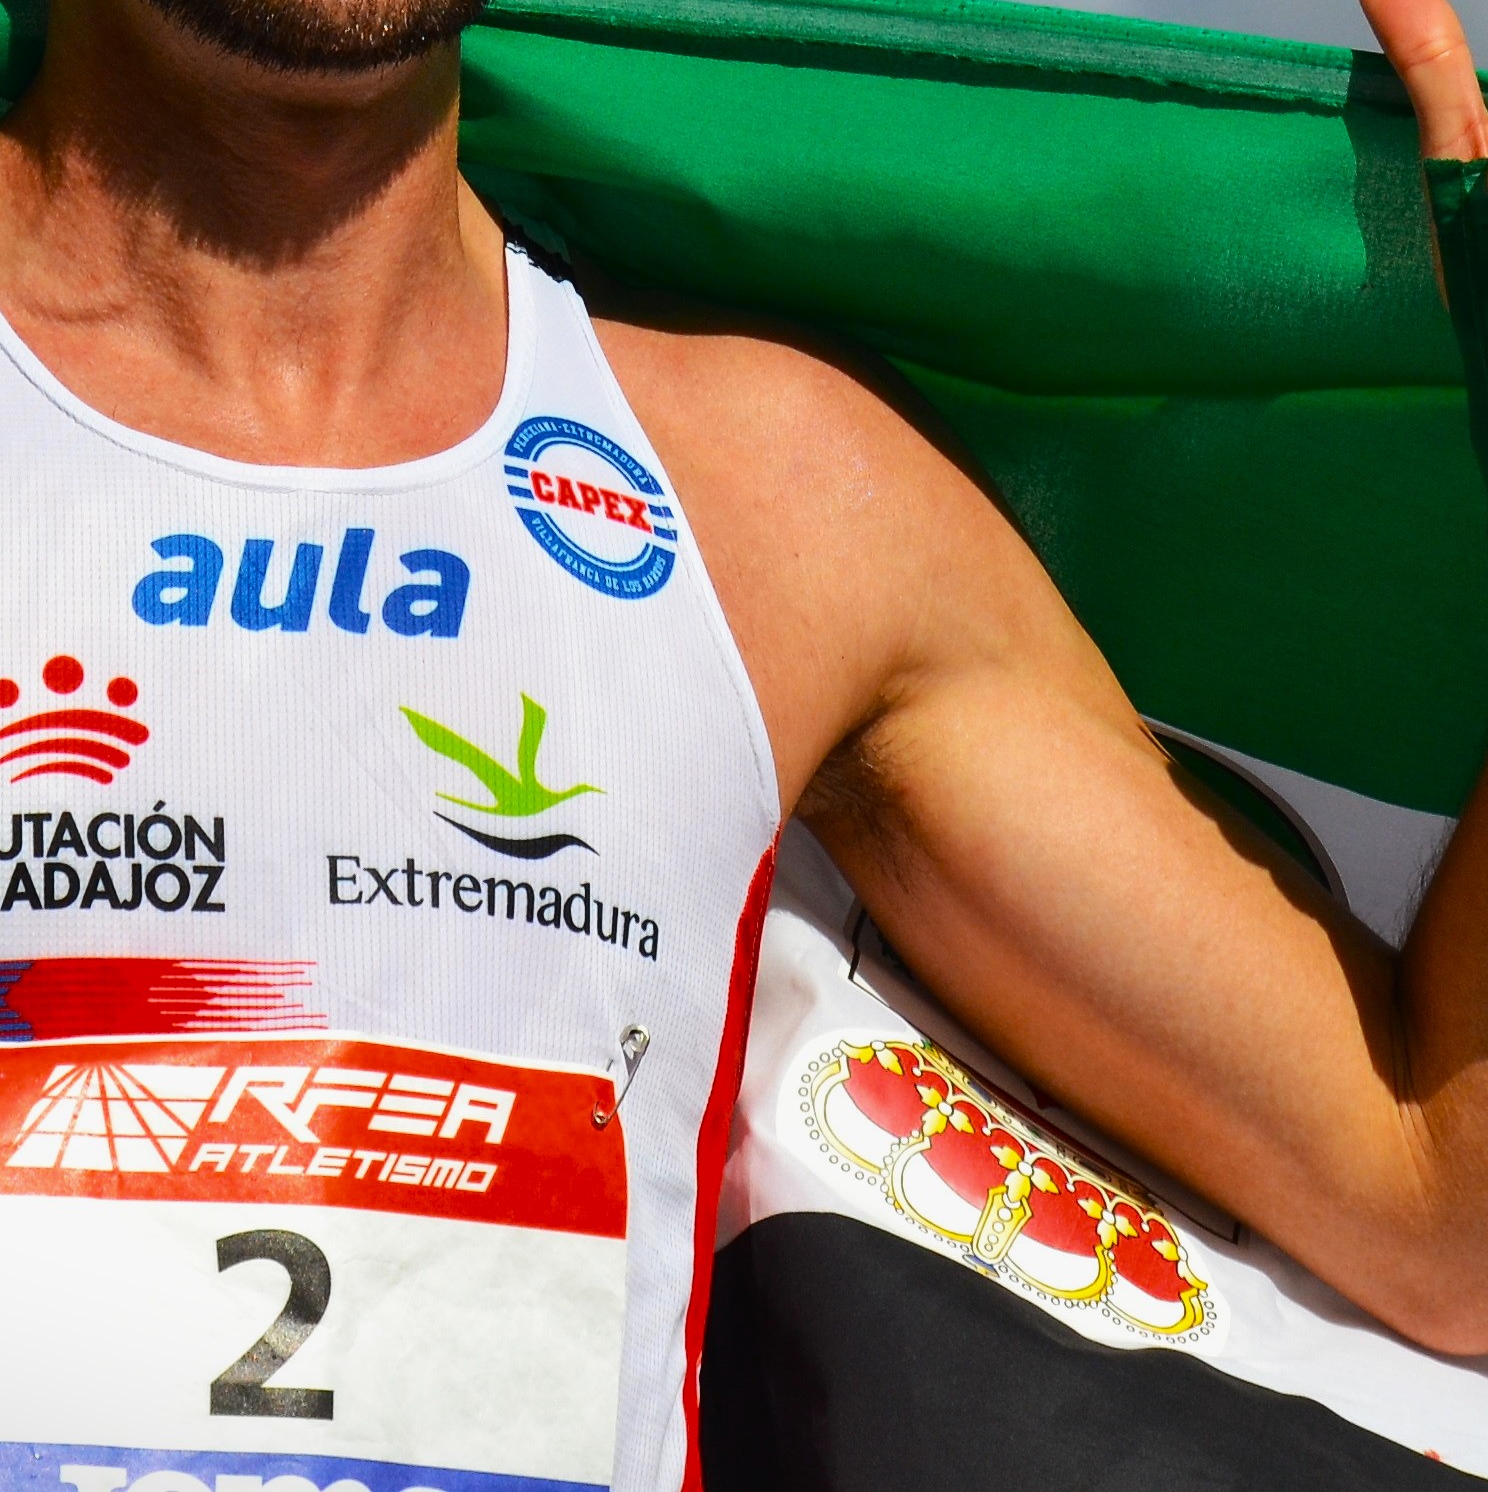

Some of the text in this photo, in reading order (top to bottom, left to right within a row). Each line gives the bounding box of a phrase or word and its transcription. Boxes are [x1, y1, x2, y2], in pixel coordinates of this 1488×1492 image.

[530, 469, 653, 535] CAPEX
[131, 526, 472, 639] aula
[325, 853, 661, 962] Extremadura
[207, 1064, 518, 1145] RFEA
[188, 1143, 498, 1194] ATLETISMO
[208, 1227, 336, 1422] 2
